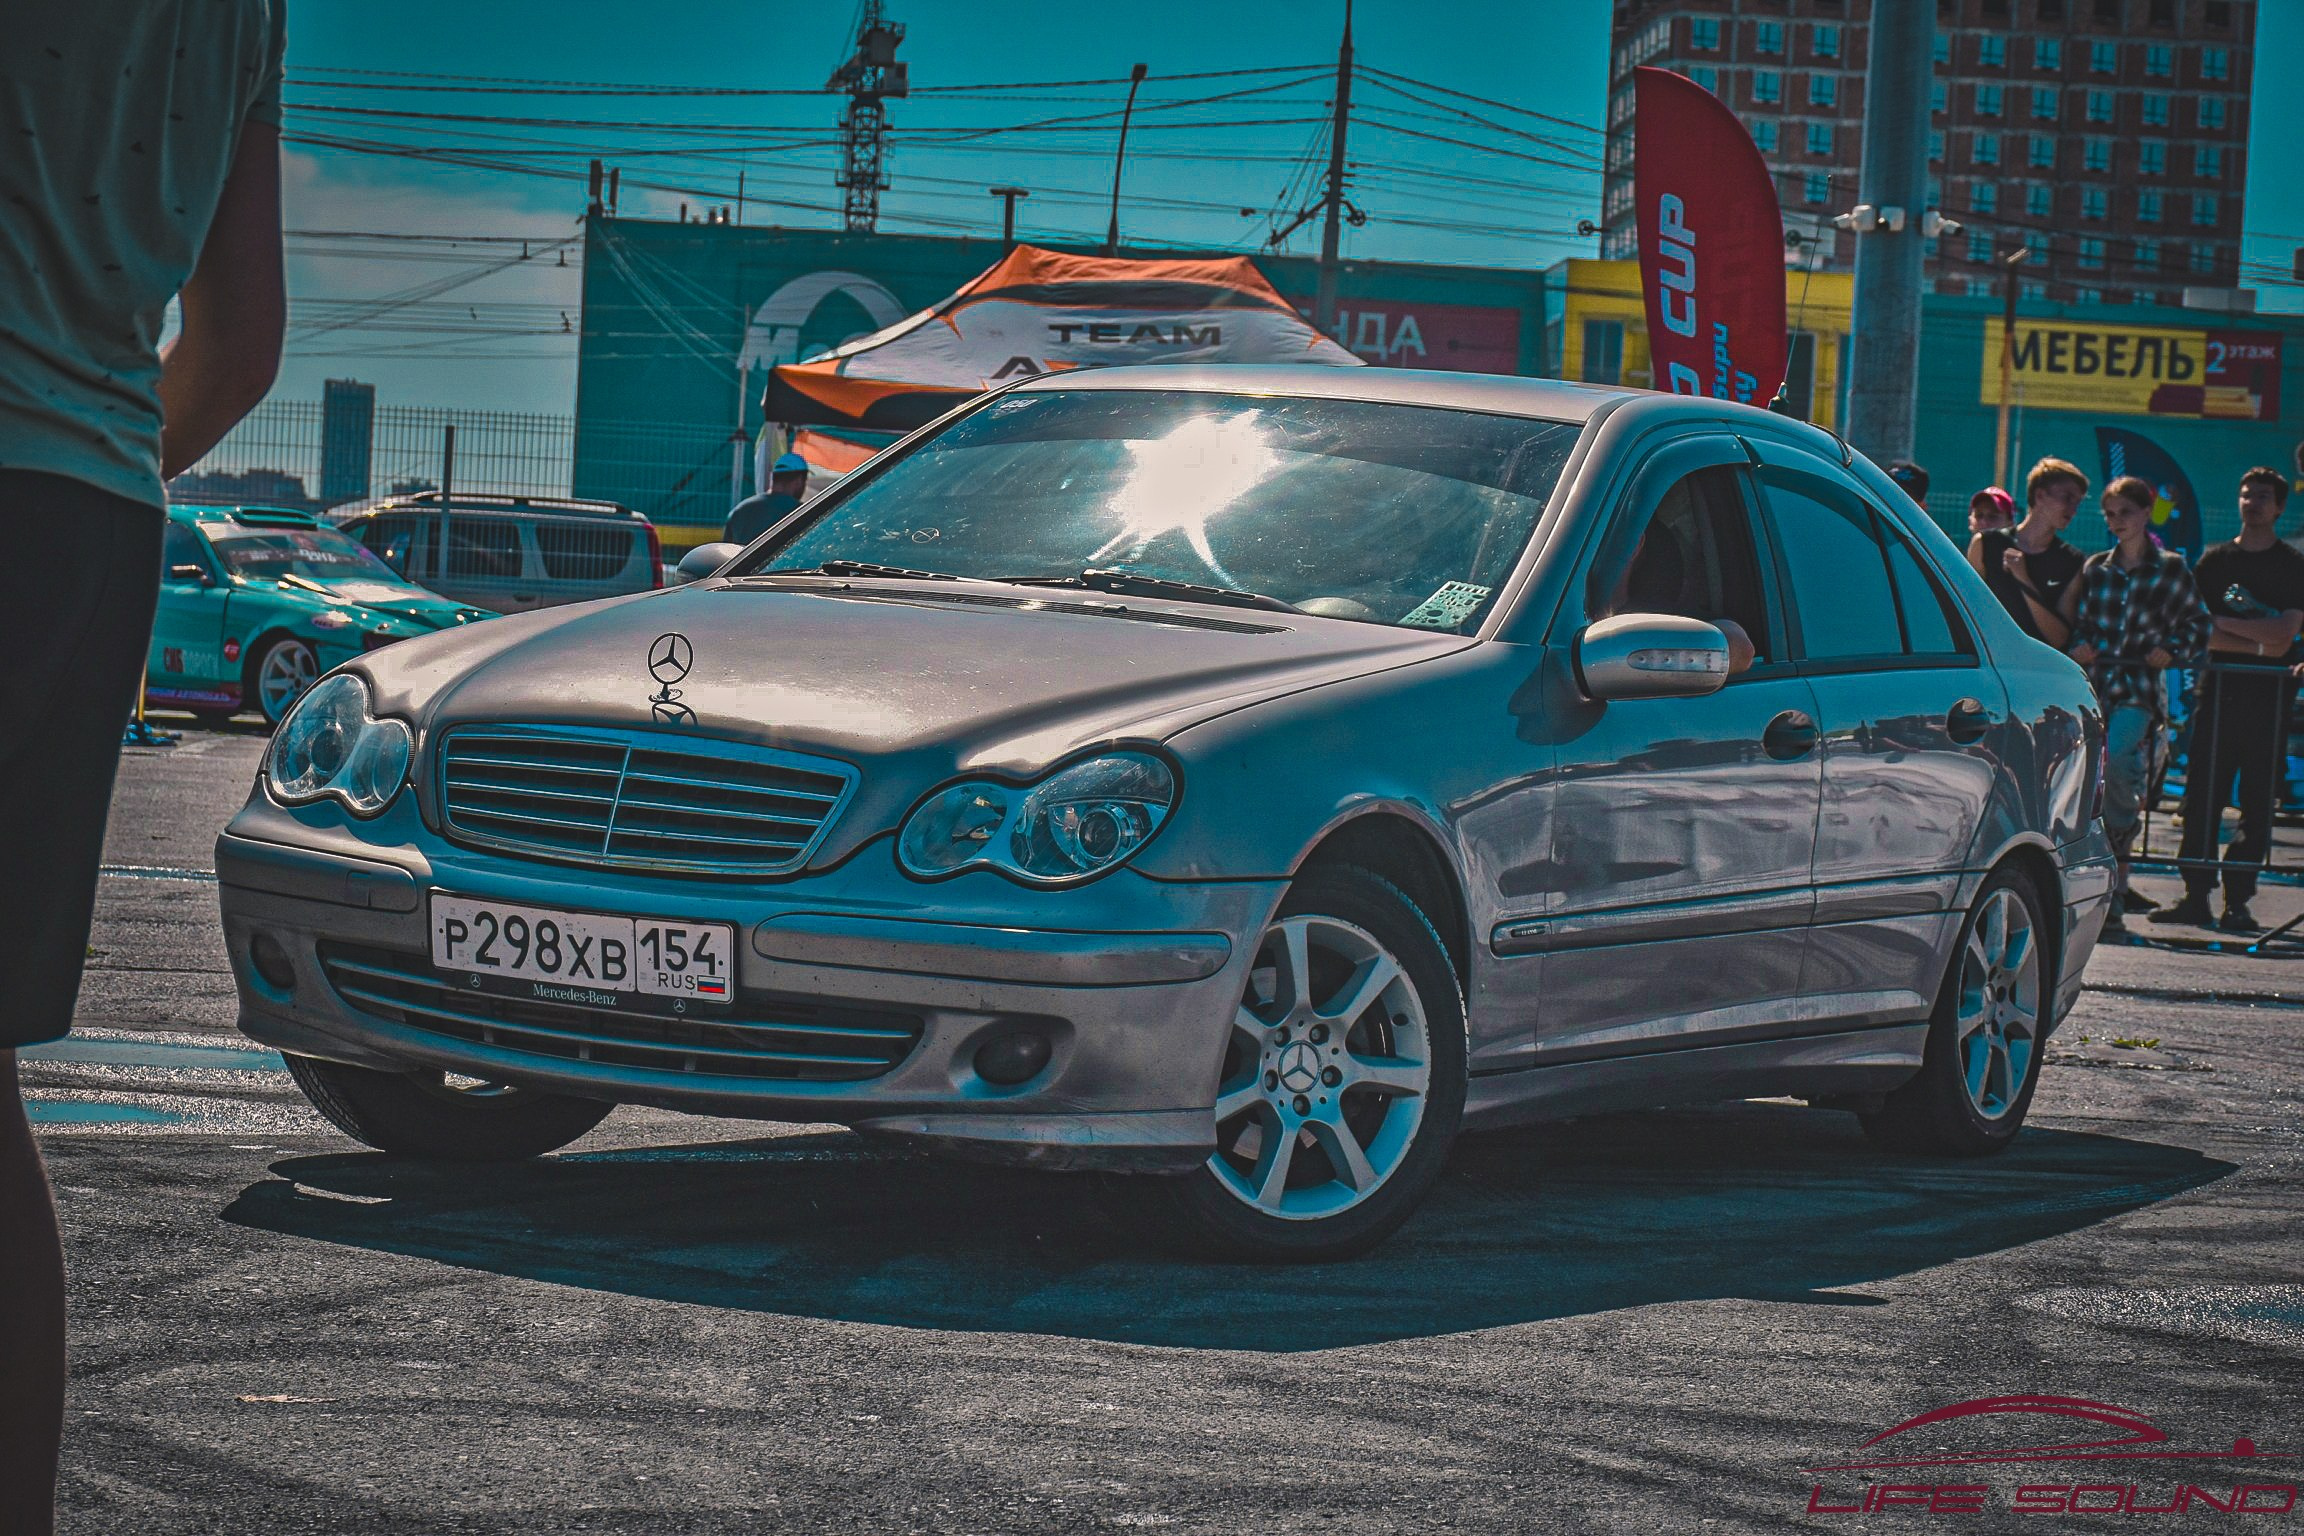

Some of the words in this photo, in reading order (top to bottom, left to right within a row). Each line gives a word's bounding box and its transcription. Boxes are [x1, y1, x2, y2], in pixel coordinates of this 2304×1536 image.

[1659, 193, 1696, 338] CUP
[1048, 324, 1222, 346] TEAM
[2000, 329, 2196, 380] МЕБЕЛЬ
[2205, 341, 2226, 374] 2
[639, 927, 716, 976] 154
[532, 982, 617, 1007] Mercedes-Benz
[657, 971, 697, 991] RUS
